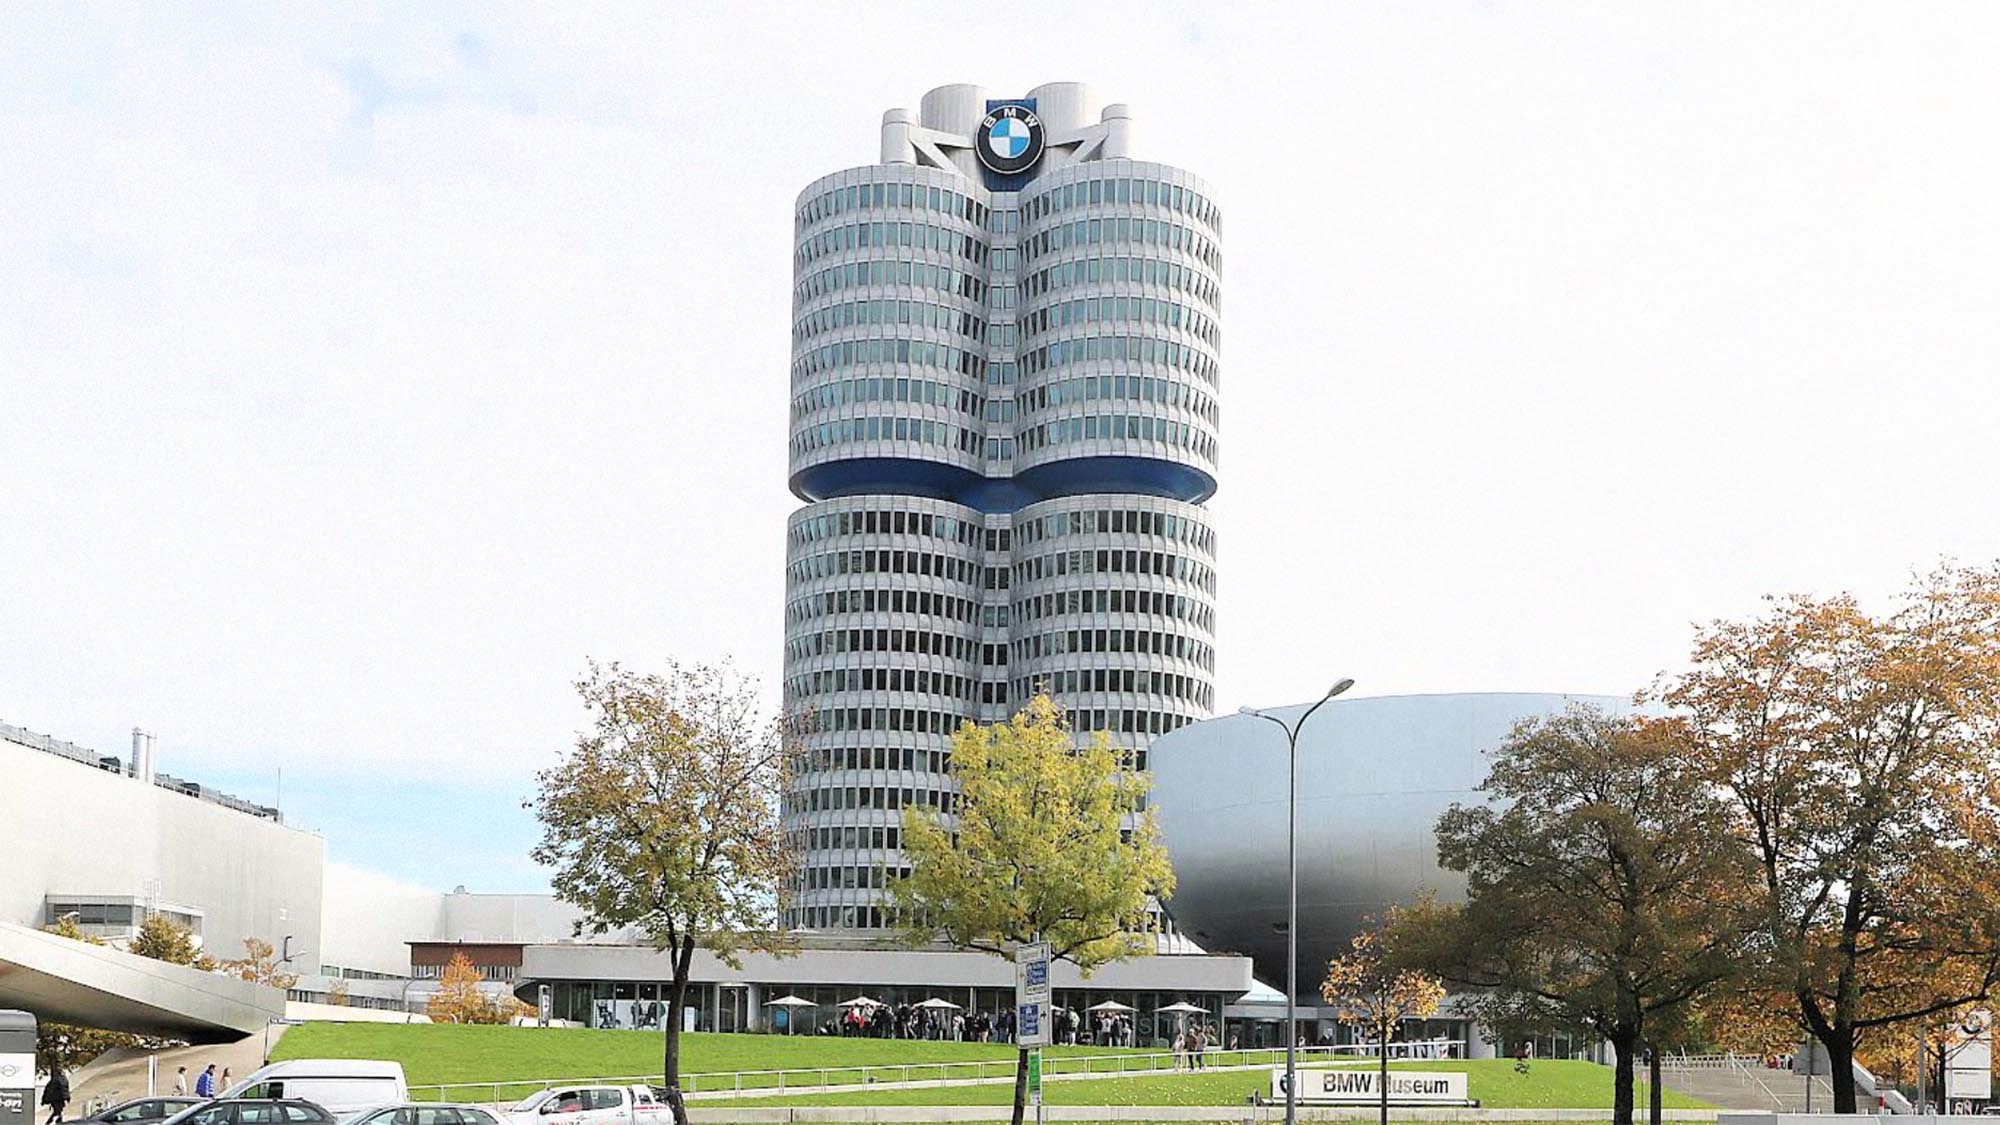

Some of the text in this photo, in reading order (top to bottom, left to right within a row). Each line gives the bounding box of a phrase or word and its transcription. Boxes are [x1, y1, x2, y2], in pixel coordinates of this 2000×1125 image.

[983, 107, 1038, 129] BMW
[1323, 1073, 1449, 1094] BMW Museum
